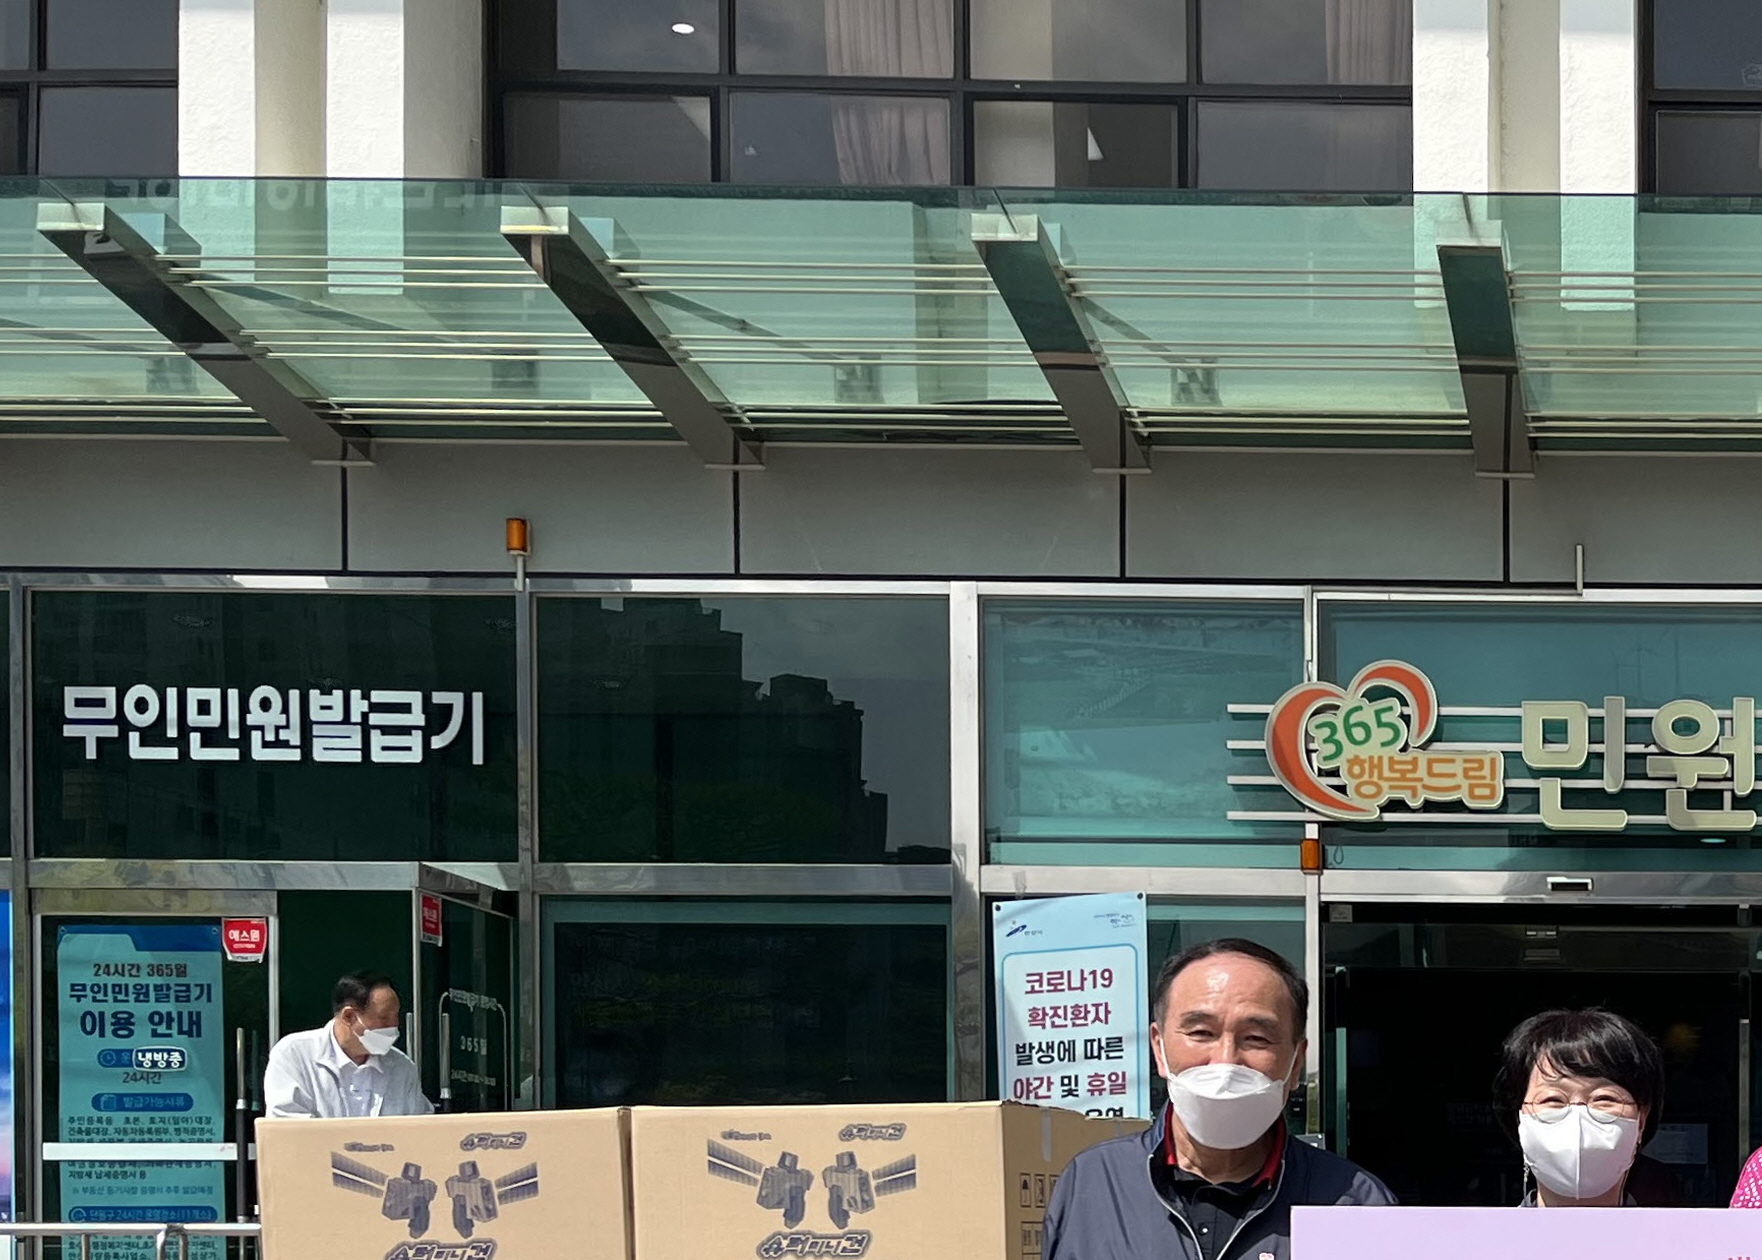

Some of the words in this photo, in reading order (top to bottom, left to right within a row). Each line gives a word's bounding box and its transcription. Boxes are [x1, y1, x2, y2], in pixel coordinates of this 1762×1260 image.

[62, 684, 485, 764] 무인민원발급기
[1314, 705, 1400, 762] 365
[1346, 755, 1497, 800] 행복드림
[94, 964, 141, 978] 24시간
[1025, 968, 1113, 995] 코로나19
[69, 983, 212, 1003] 무인민원발급기
[80, 1010, 135, 1038] 이용
[148, 1011, 202, 1038] 안내
[1028, 1002, 1111, 1029] 확진환자
[137, 1051, 183, 1068] 냉방중
[1015, 1039, 1076, 1066] 발생에
[1084, 1036, 1124, 1061] 따른
[122, 1072, 162, 1084] 24시간
[1013, 1076, 1054, 1100] 야간
[1060, 1075, 1079, 1098] 및
[1087, 1071, 1126, 1097] 휴일
[760, 1234, 868, 1257] 슈퍼미니건
